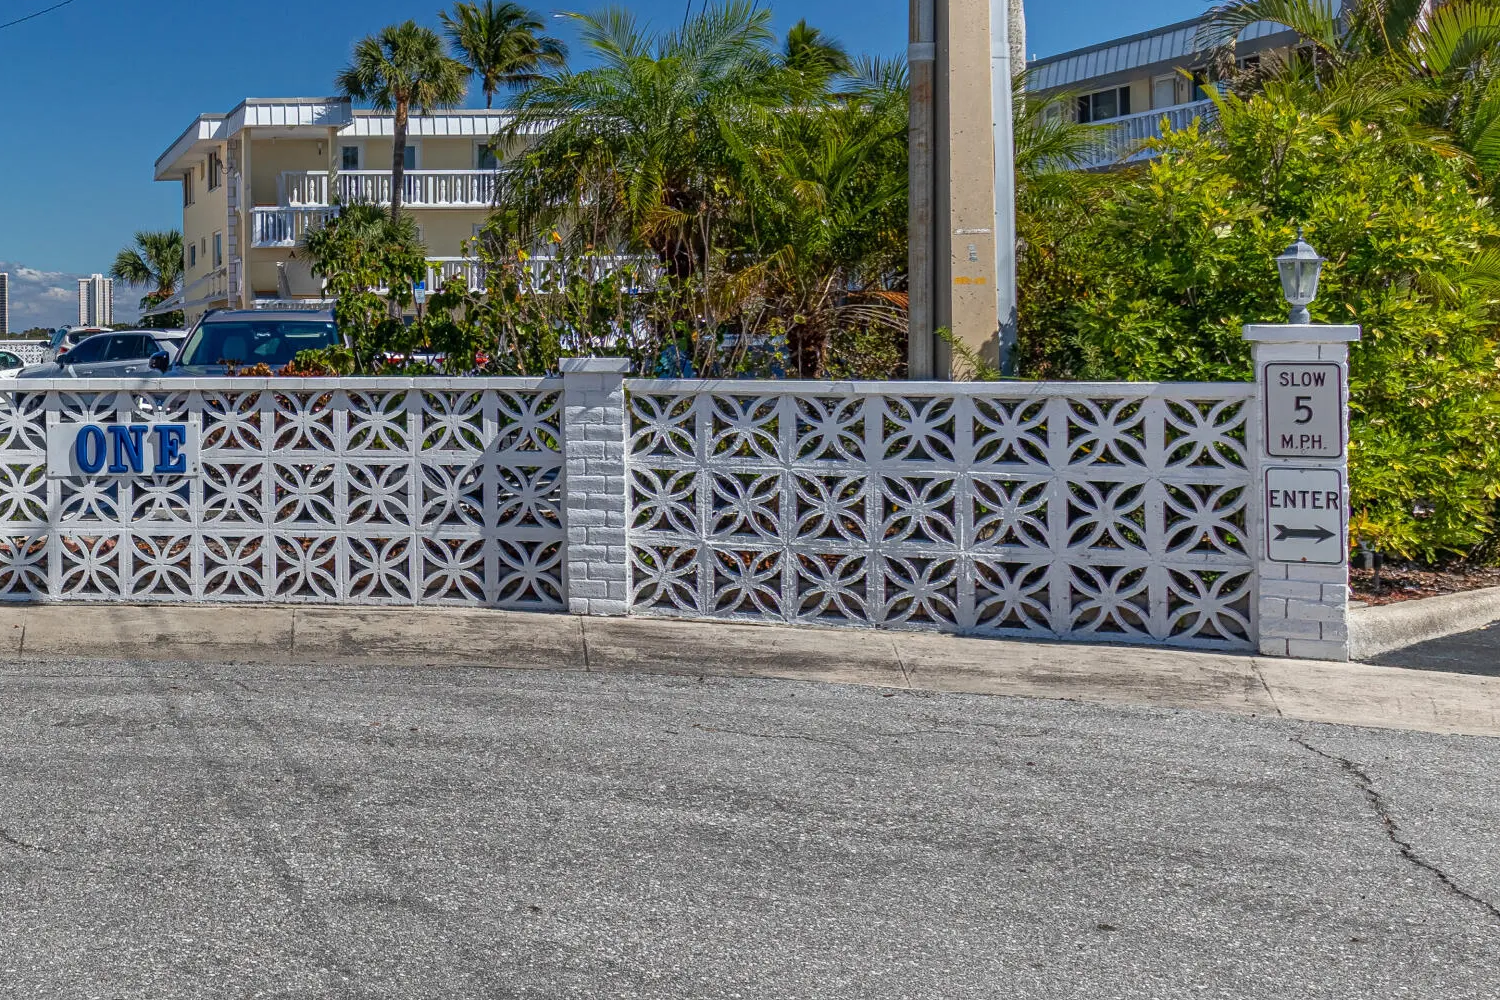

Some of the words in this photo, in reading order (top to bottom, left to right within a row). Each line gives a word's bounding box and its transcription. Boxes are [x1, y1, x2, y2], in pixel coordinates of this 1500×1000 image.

[289, 250, 296, 258] A
[1279, 371, 1326, 387] SLOW
[1293, 396, 1313, 424] 5
[75, 424, 187, 474] ONE
[1269, 489, 1339, 510] ENTER
